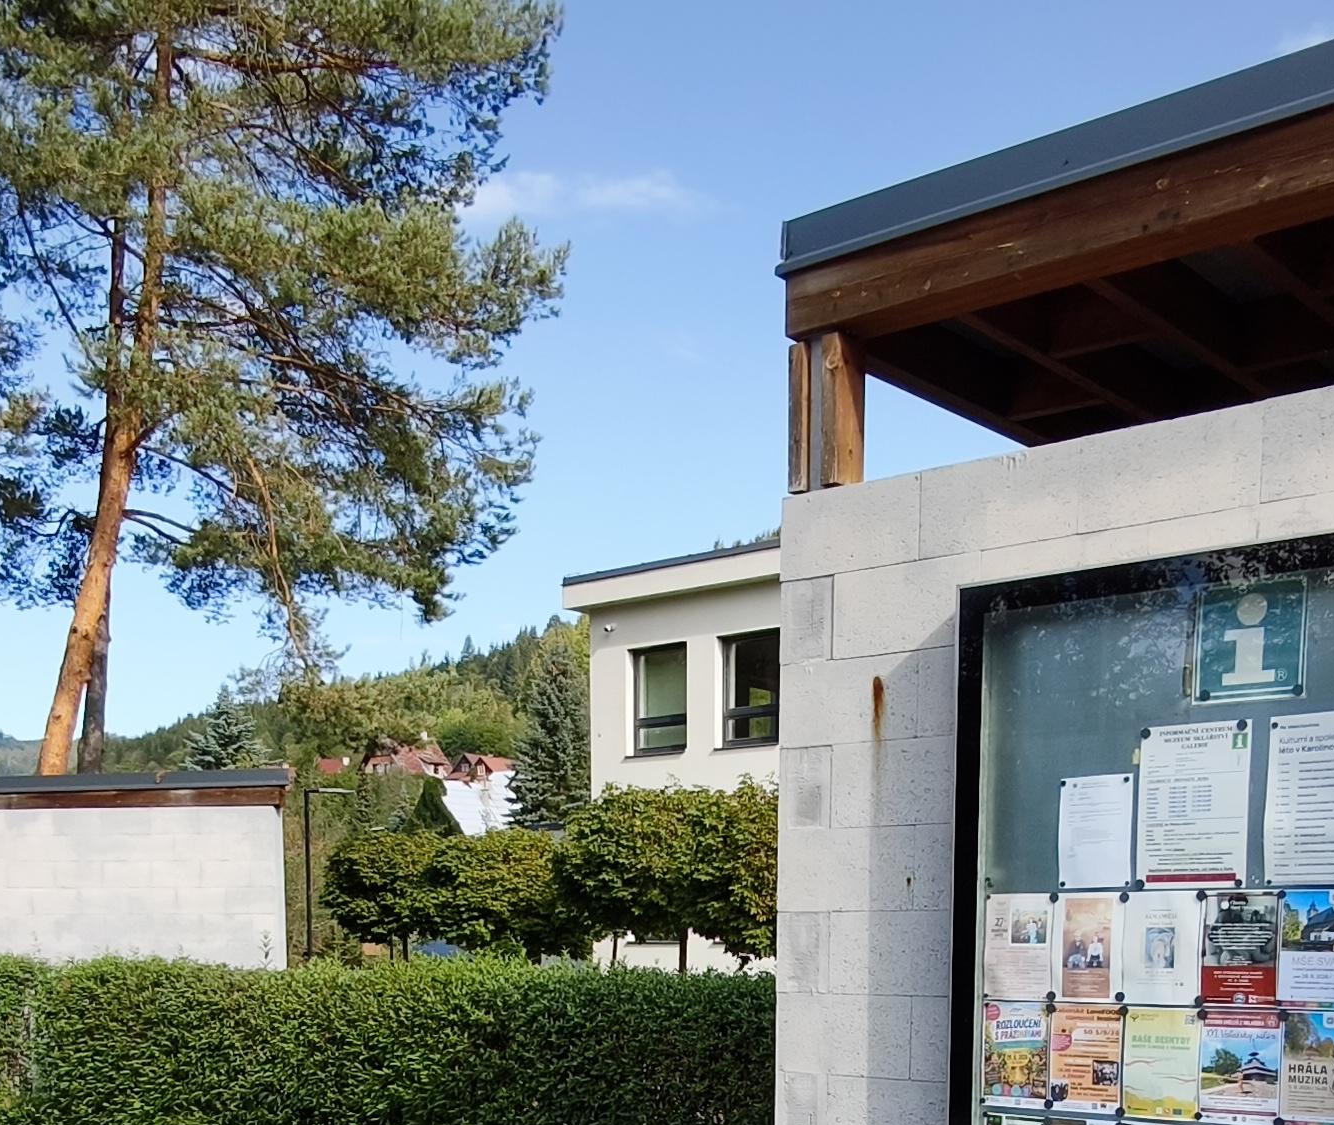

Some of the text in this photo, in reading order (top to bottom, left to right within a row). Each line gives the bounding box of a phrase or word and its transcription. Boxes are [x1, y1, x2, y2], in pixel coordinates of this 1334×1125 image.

[1201, 726, 1233, 734] CENTRUM
[1279, 745, 1295, 754] léto
[996, 1015, 1042, 1029] ROZLOUČENÍ
[1288, 1062, 1328, 1075] HRÁLA
[1288, 1075, 1328, 1085] MUZIKA
